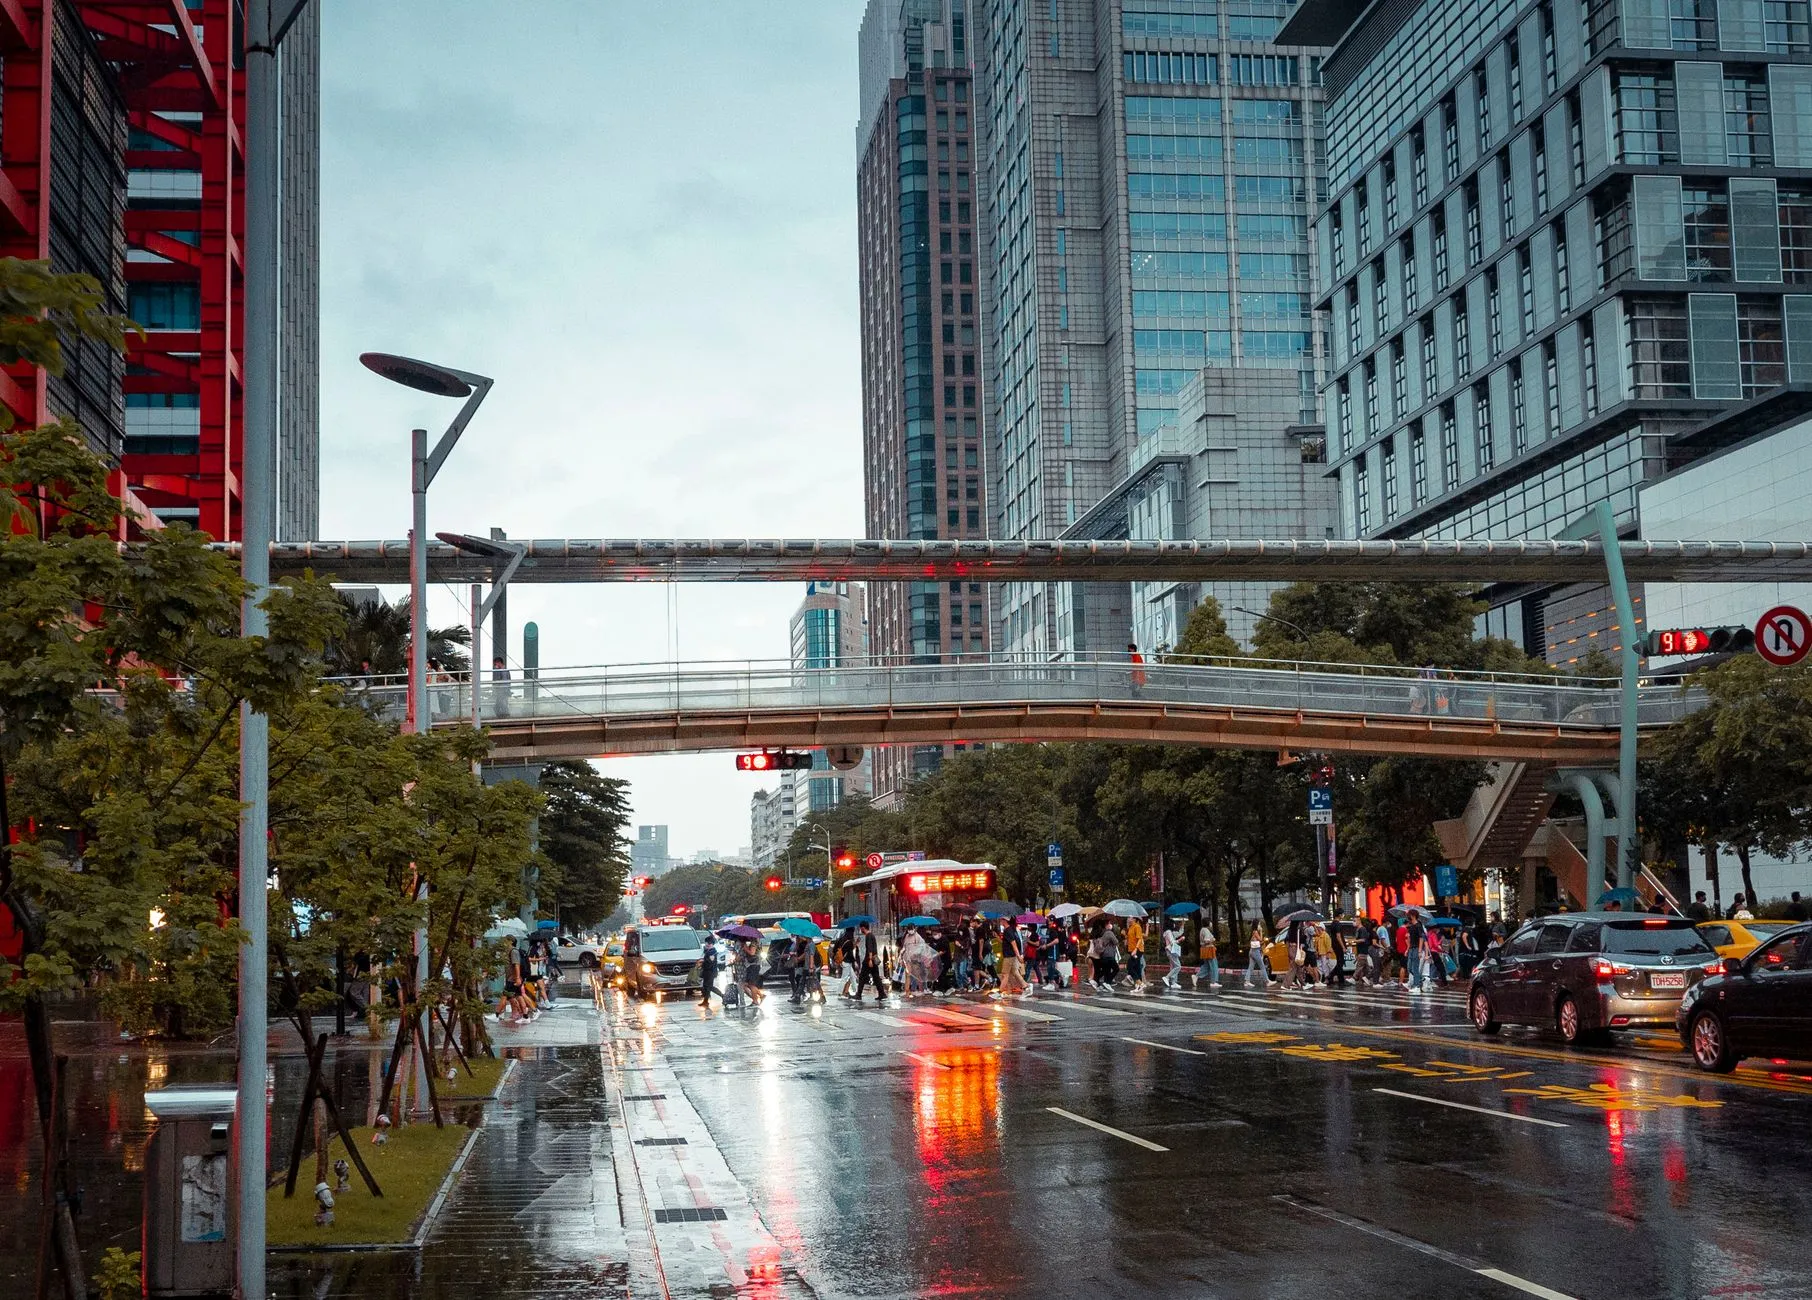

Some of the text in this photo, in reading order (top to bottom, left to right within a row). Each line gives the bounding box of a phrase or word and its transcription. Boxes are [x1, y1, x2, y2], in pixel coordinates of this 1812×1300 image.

[1663, 632, 1673, 652] 9
[743, 756, 751, 769] 9
[1311, 790, 1321, 804] P
[1048, 844, 1055, 854] P
[1050, 870, 1057, 879] P
